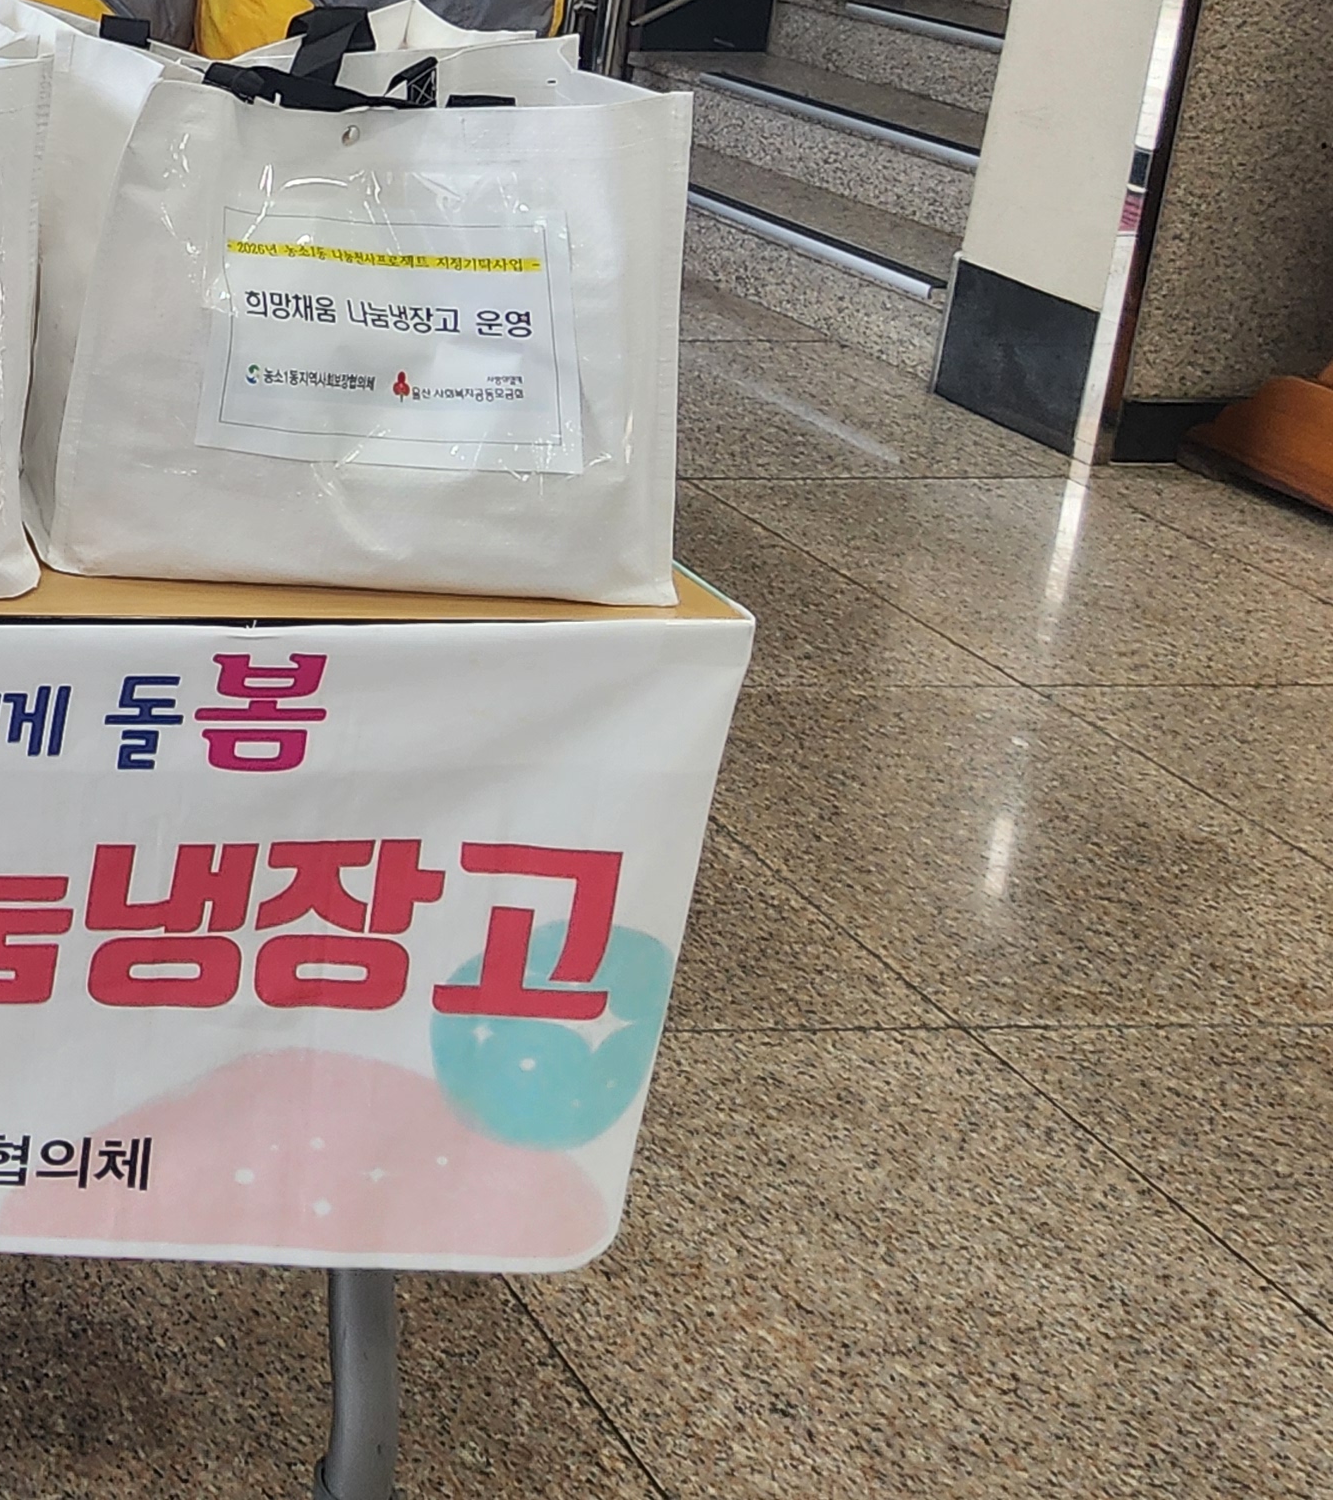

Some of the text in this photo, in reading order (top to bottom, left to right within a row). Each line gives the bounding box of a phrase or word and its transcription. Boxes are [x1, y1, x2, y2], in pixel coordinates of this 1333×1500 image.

[236, 242, 278, 255] 2026년
[244, 289, 533, 338] 희망채움 나눔냉장고 운영
[263, 368, 376, 391] 농소1동지역사회보장협의체
[104, 652, 329, 774] 돌봄
